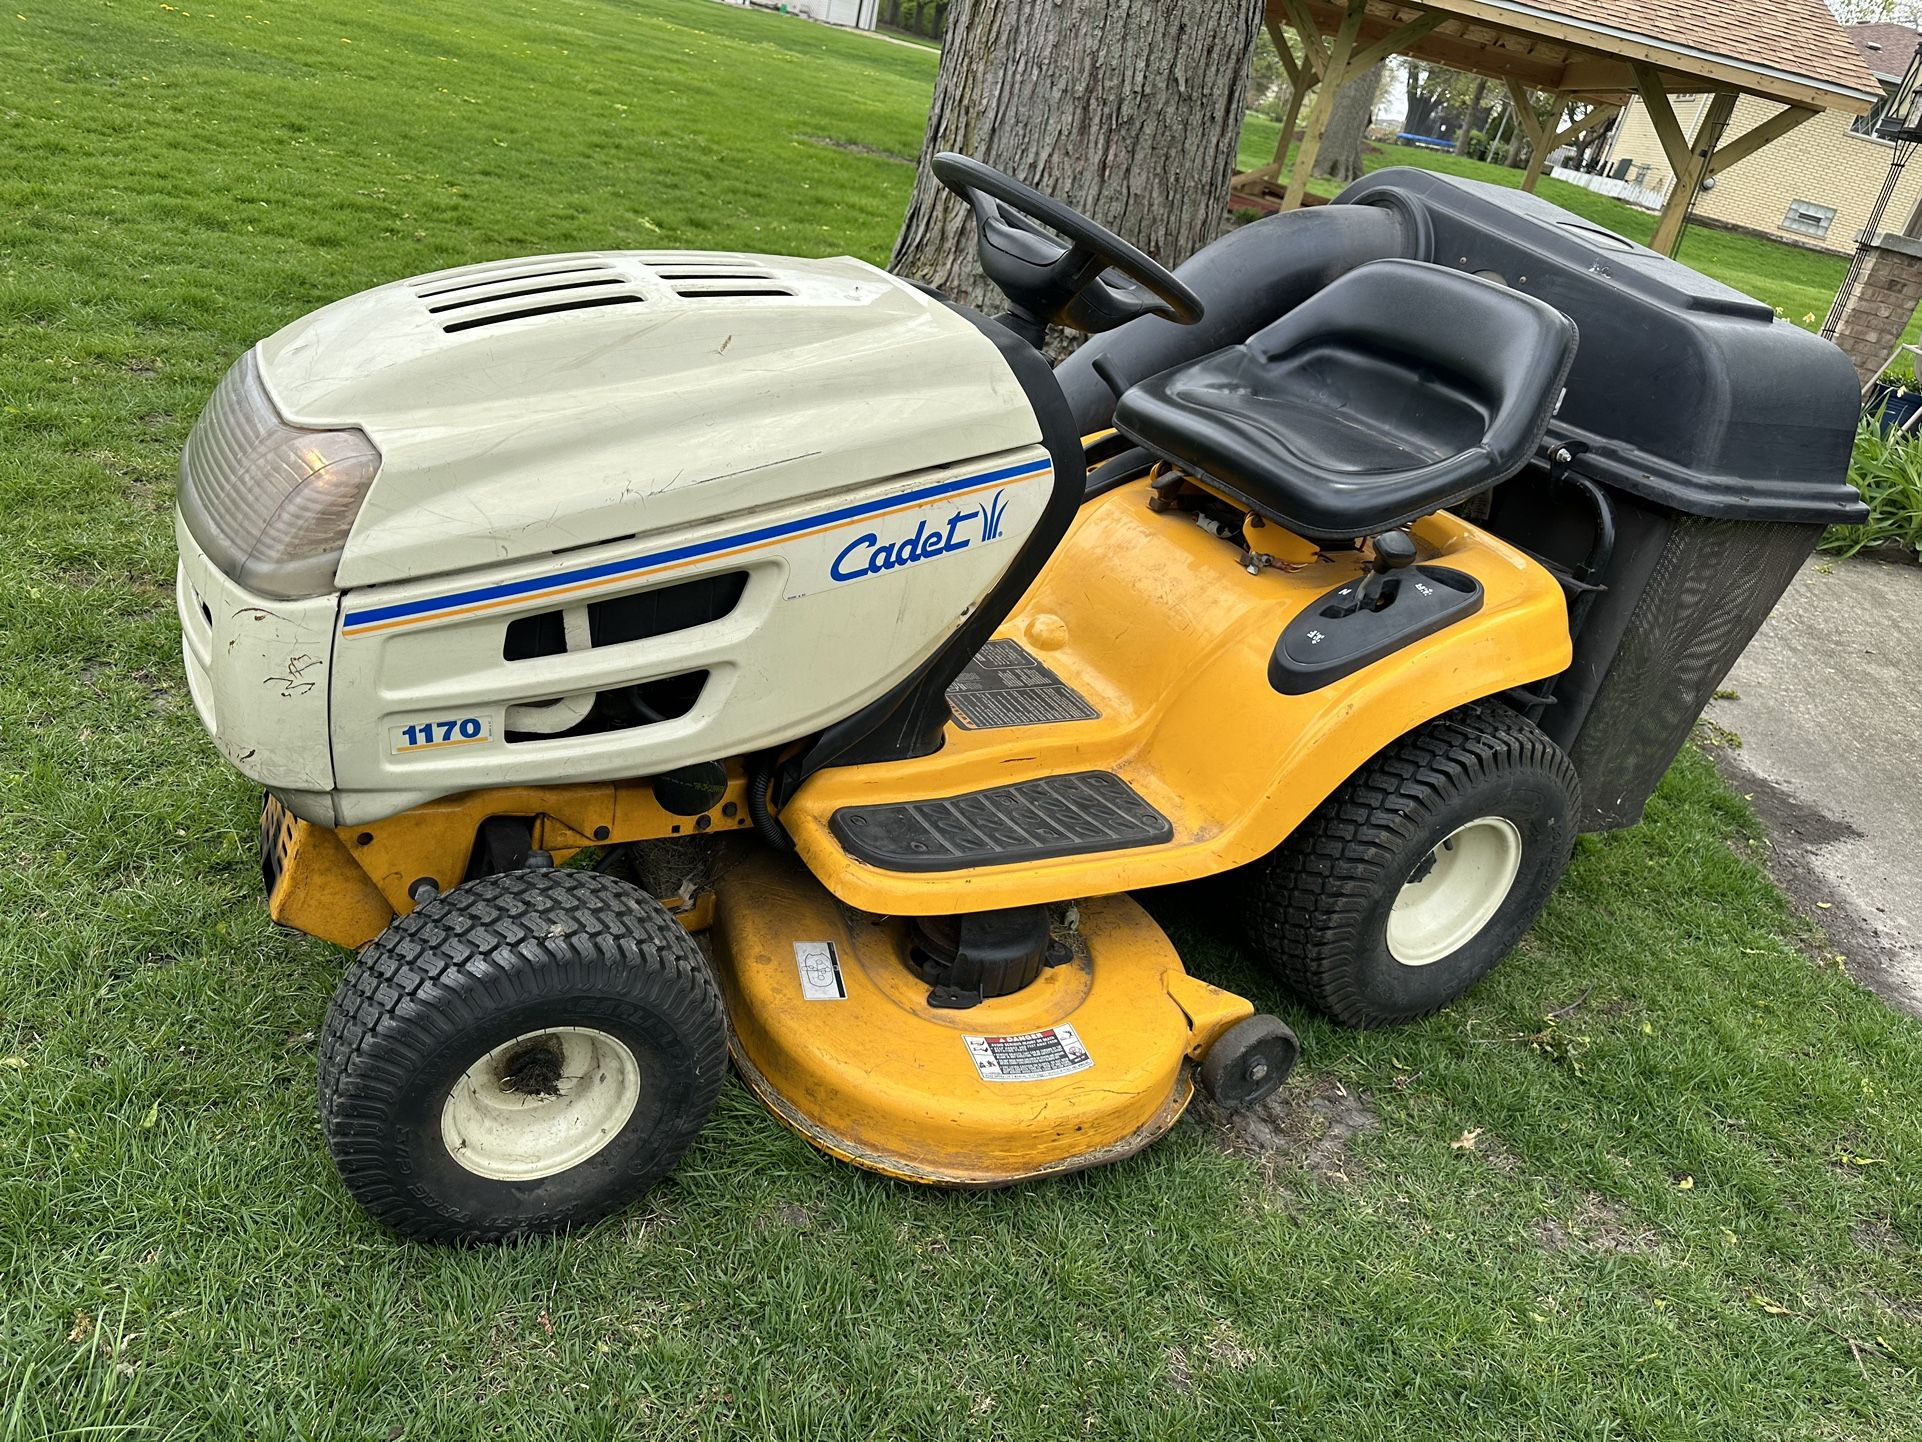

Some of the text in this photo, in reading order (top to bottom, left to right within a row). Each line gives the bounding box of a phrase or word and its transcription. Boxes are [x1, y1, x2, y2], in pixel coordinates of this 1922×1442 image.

[830, 511, 980, 582] Cadet
[402, 718, 482, 746] 1170
[1006, 1032, 1043, 1042] DANGER
